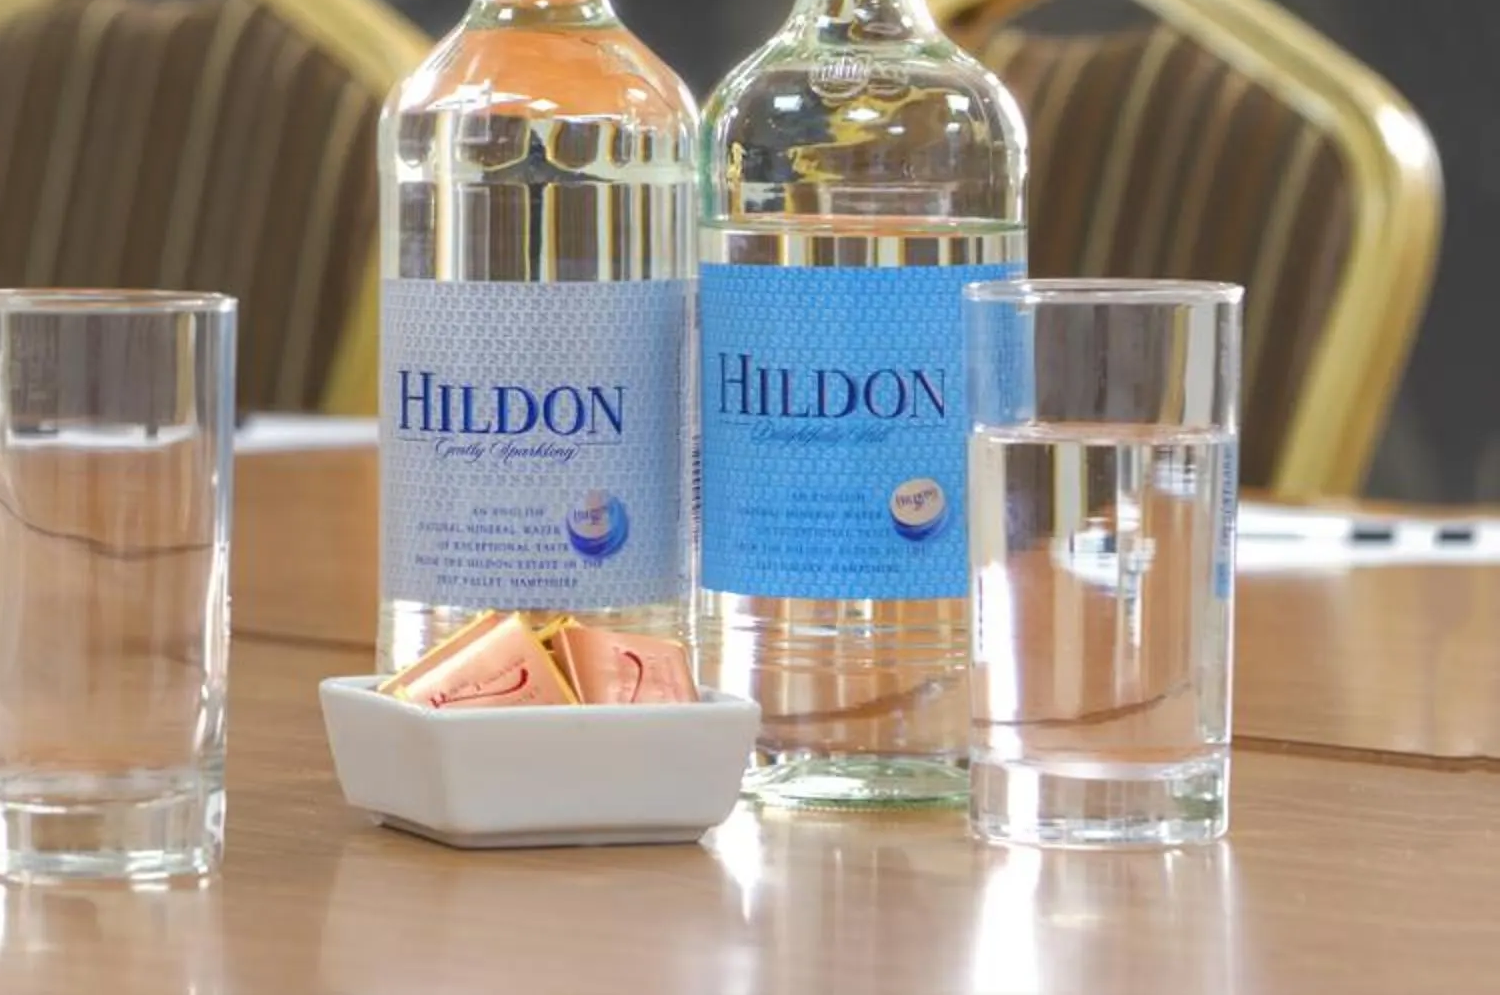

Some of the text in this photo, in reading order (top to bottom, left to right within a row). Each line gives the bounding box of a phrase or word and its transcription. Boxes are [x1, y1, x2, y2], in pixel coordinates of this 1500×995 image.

[397, 370, 627, 437] HILDON
[718, 352, 947, 421] HILDON
[435, 437, 579, 465] Gently Sparkling
